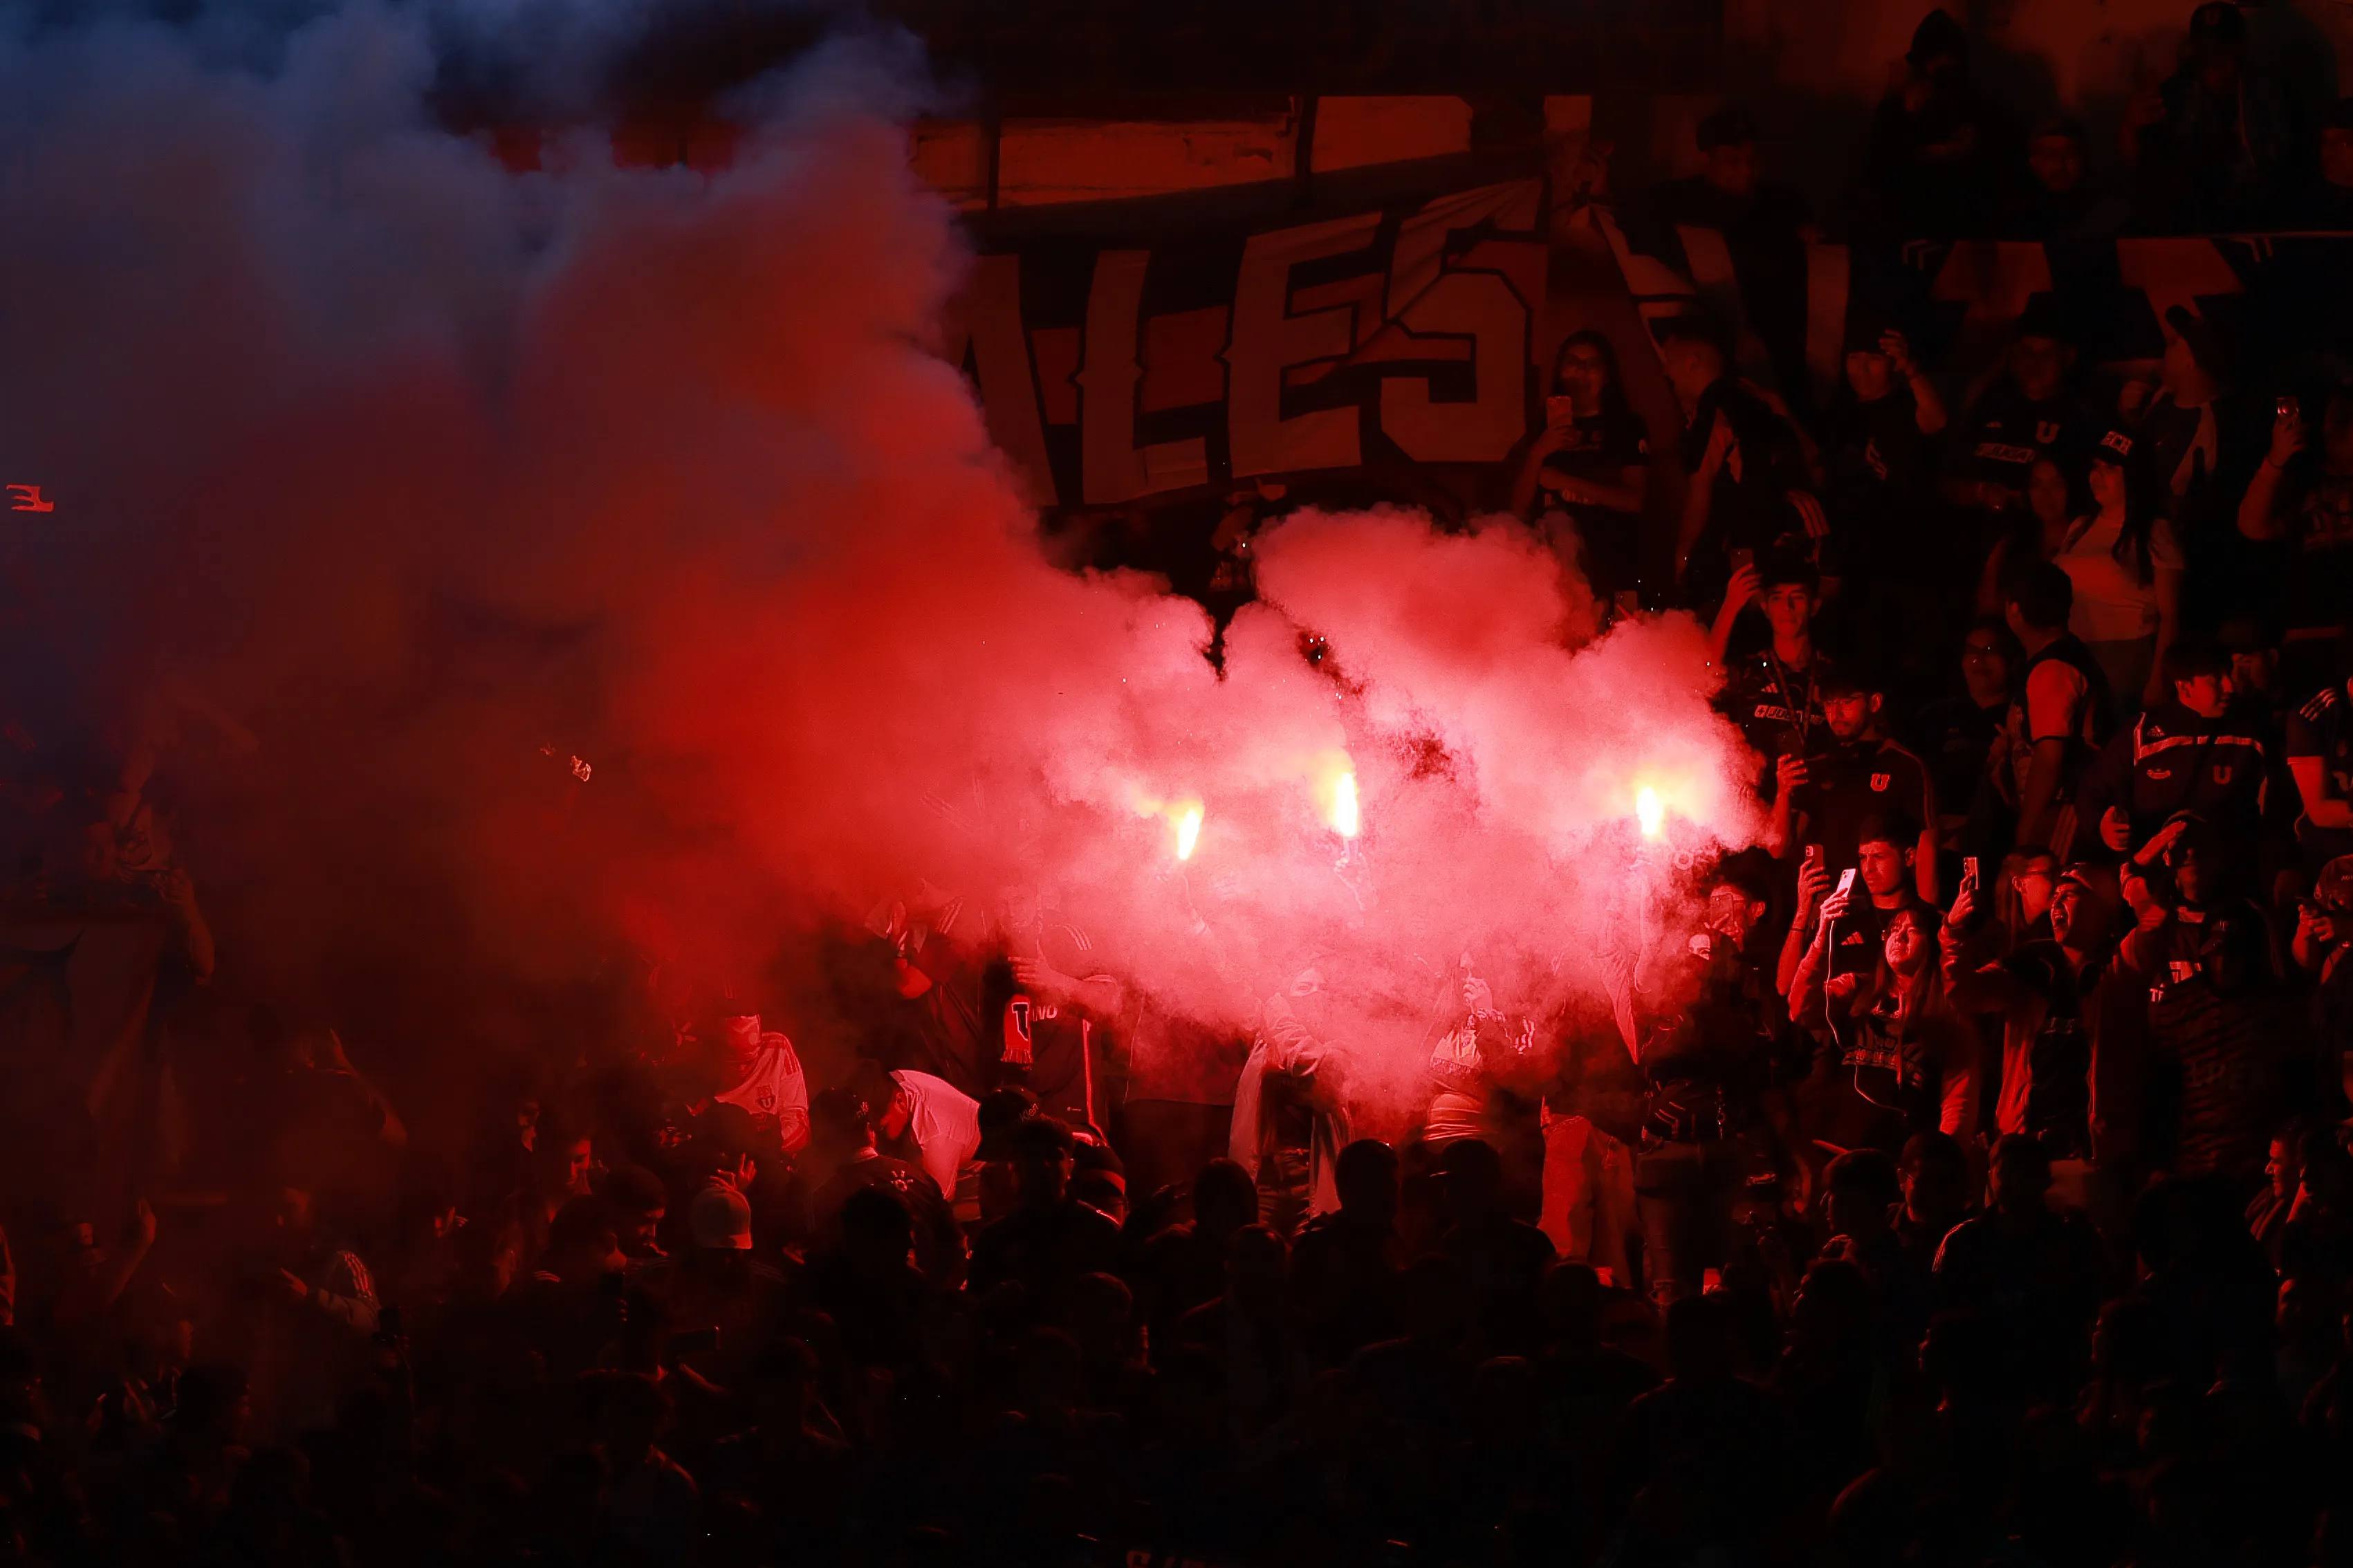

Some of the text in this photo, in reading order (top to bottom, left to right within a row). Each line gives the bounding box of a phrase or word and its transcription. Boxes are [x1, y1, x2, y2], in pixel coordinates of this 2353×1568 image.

[2036, 420, 2062, 444] U
[1870, 773, 1892, 793] U
[2213, 765, 2233, 785] U
[762, 1097, 772, 1108] U
